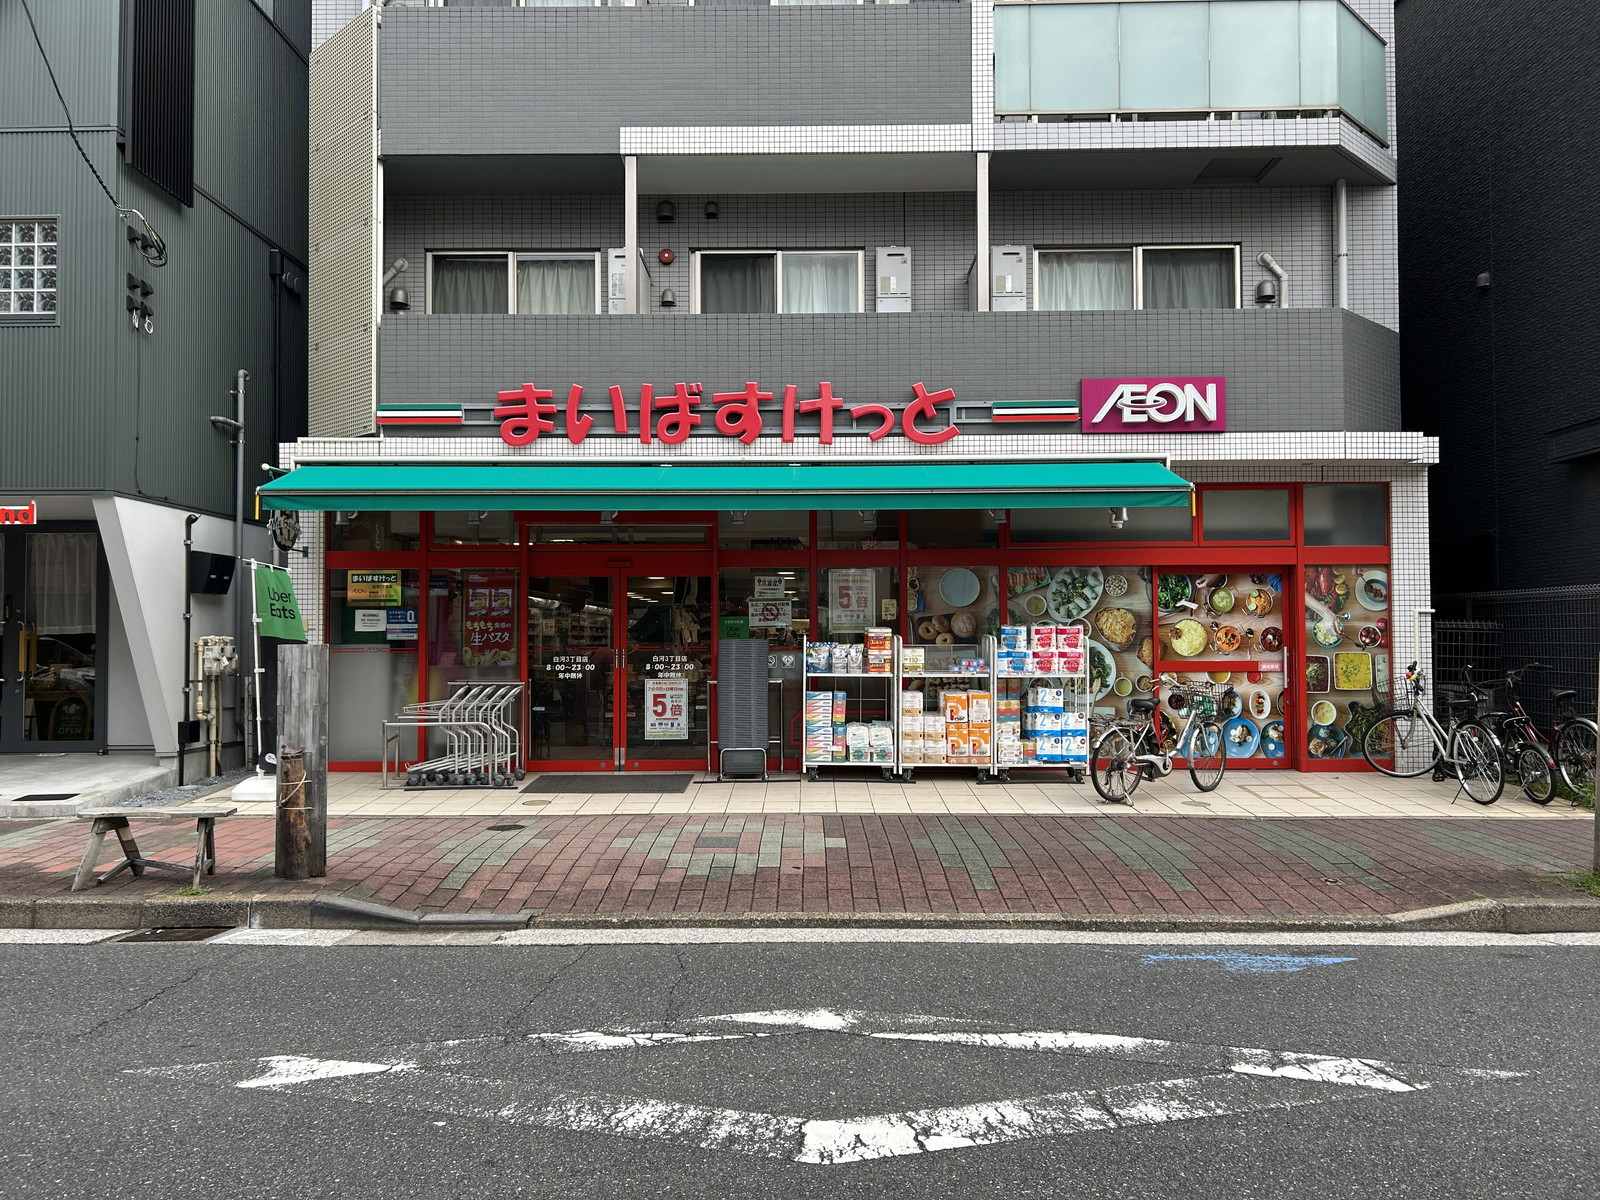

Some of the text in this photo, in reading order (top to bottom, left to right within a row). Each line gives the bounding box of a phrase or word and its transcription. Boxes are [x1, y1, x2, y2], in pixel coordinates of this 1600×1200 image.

[493, 381, 959, 447] まいばすけっと
[268, 586, 292, 604] Uber
[269, 602, 296, 620] Eats
[470, 632, 510, 646] 生パスタ
[558, 672, 583, 680] 年中無休
[657, 671, 682, 679] 年中無休
[652, 693, 668, 718] 5
